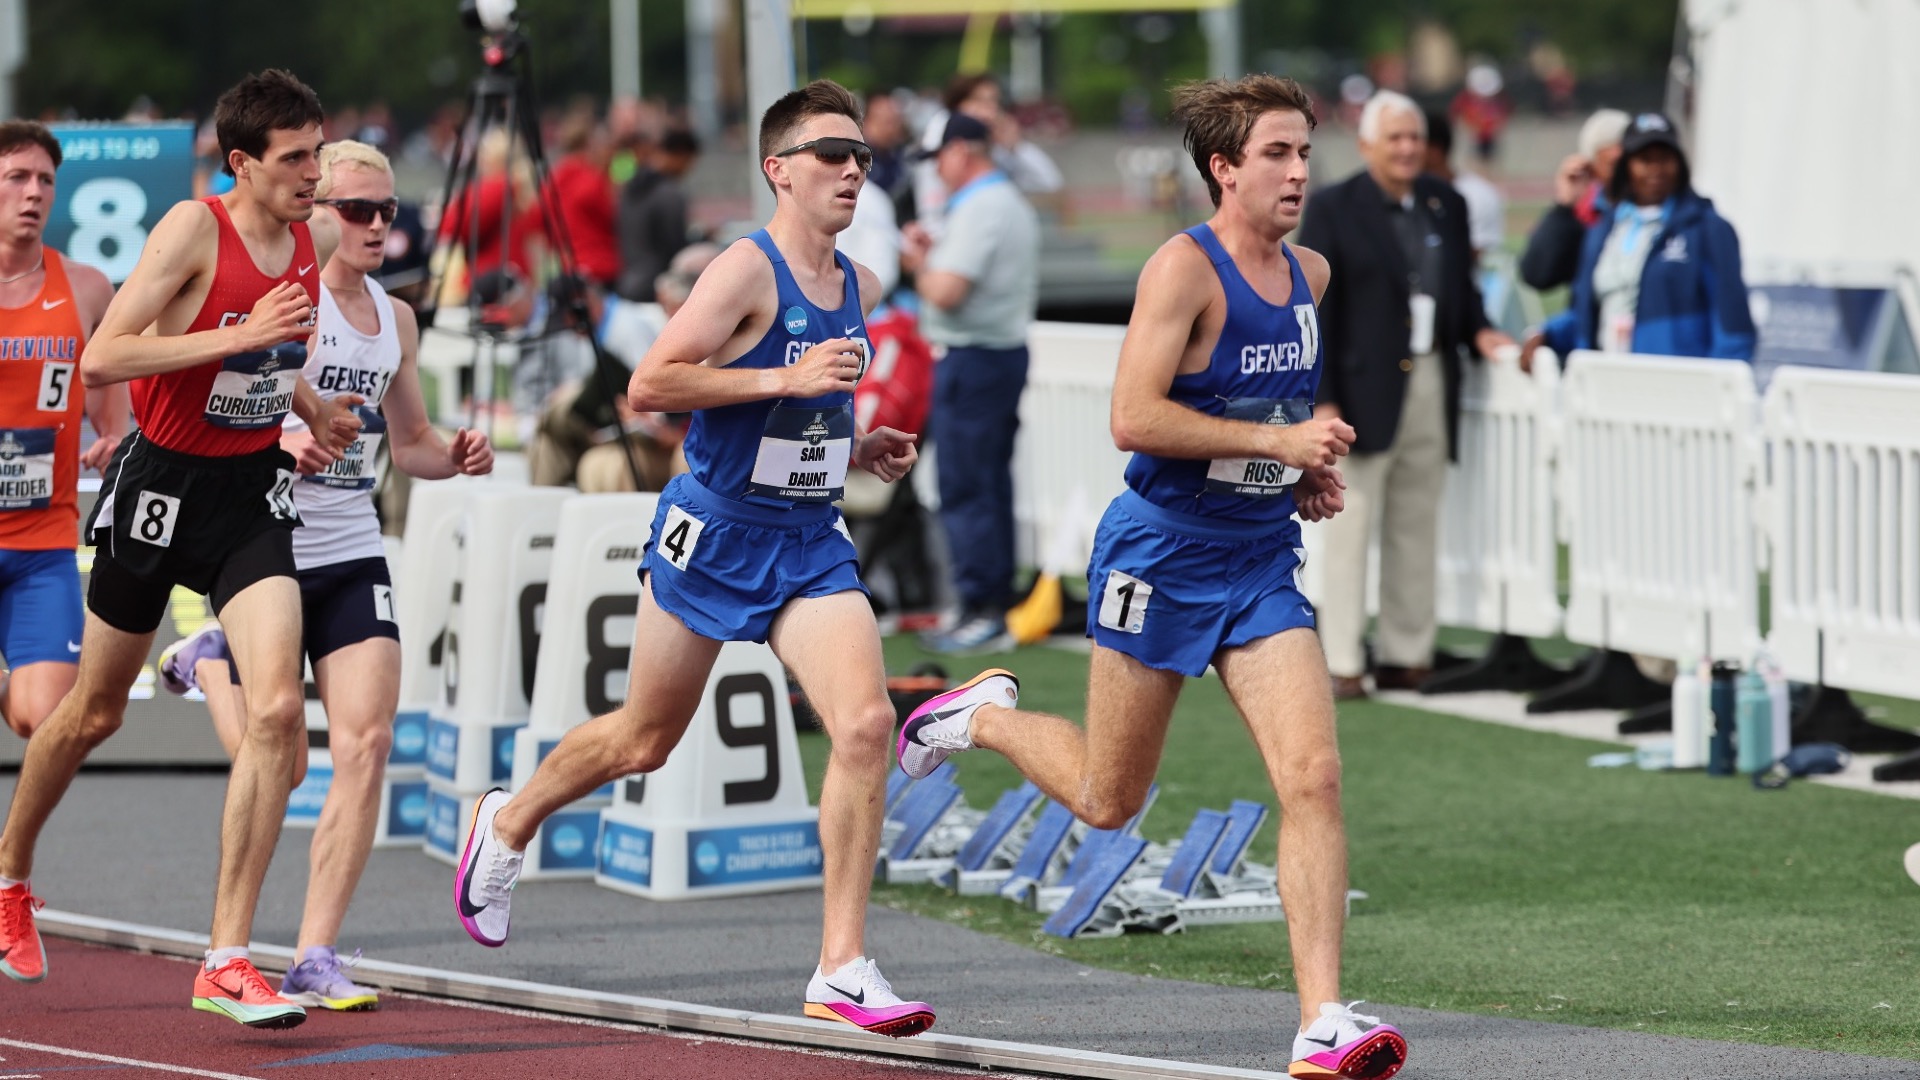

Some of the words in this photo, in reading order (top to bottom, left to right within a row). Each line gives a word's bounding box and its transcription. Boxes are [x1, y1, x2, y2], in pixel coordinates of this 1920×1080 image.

[63, 137, 99, 160] APS
[68, 176, 148, 284] 8
[788, 319, 807, 329] NCAA
[1304, 311, 1313, 362] 1
[0, 336, 77, 361] TEVILLE
[1241, 342, 1313, 374] GENER
[47, 369, 67, 408] 5
[246, 378, 278, 394] JACOB
[318, 365, 378, 396] GENES
[208, 391, 293, 415] CURULEWSKI
[343, 440, 366, 455] ERCE
[800, 446, 826, 461] SAM
[788, 471, 828, 487] DAUNT
[1243, 461, 1286, 484] RUSH
[272, 477, 290, 515] 8
[140, 498, 168, 541] 8
[665, 519, 691, 563] 4
[1117, 582, 1136, 628] 1
[715, 673, 781, 806] 9
[725, 845, 821, 873] CHAMPIONSHIPS
